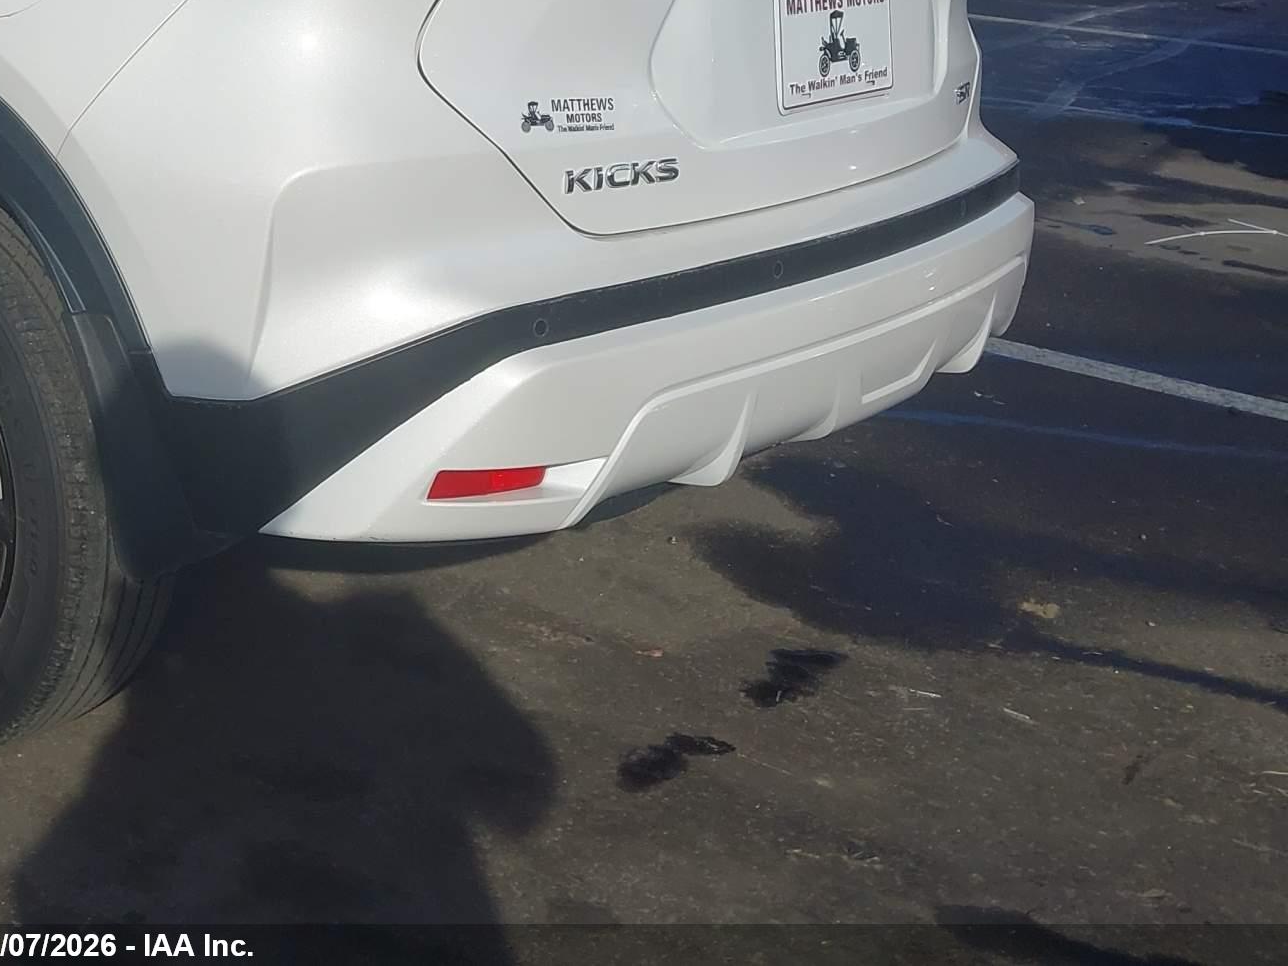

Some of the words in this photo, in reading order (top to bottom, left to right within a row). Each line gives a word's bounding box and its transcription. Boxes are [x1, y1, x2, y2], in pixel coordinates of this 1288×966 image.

[790, 83, 806, 95] The
[808, 76, 837, 92] Walkin'
[840, 72, 862, 86] Man's
[865, 66, 888, 82] Friend
[551, 97, 614, 112] MATTHEWS
[566, 112, 602, 124] MOTORS
[564, 157, 679, 194] KICKS
